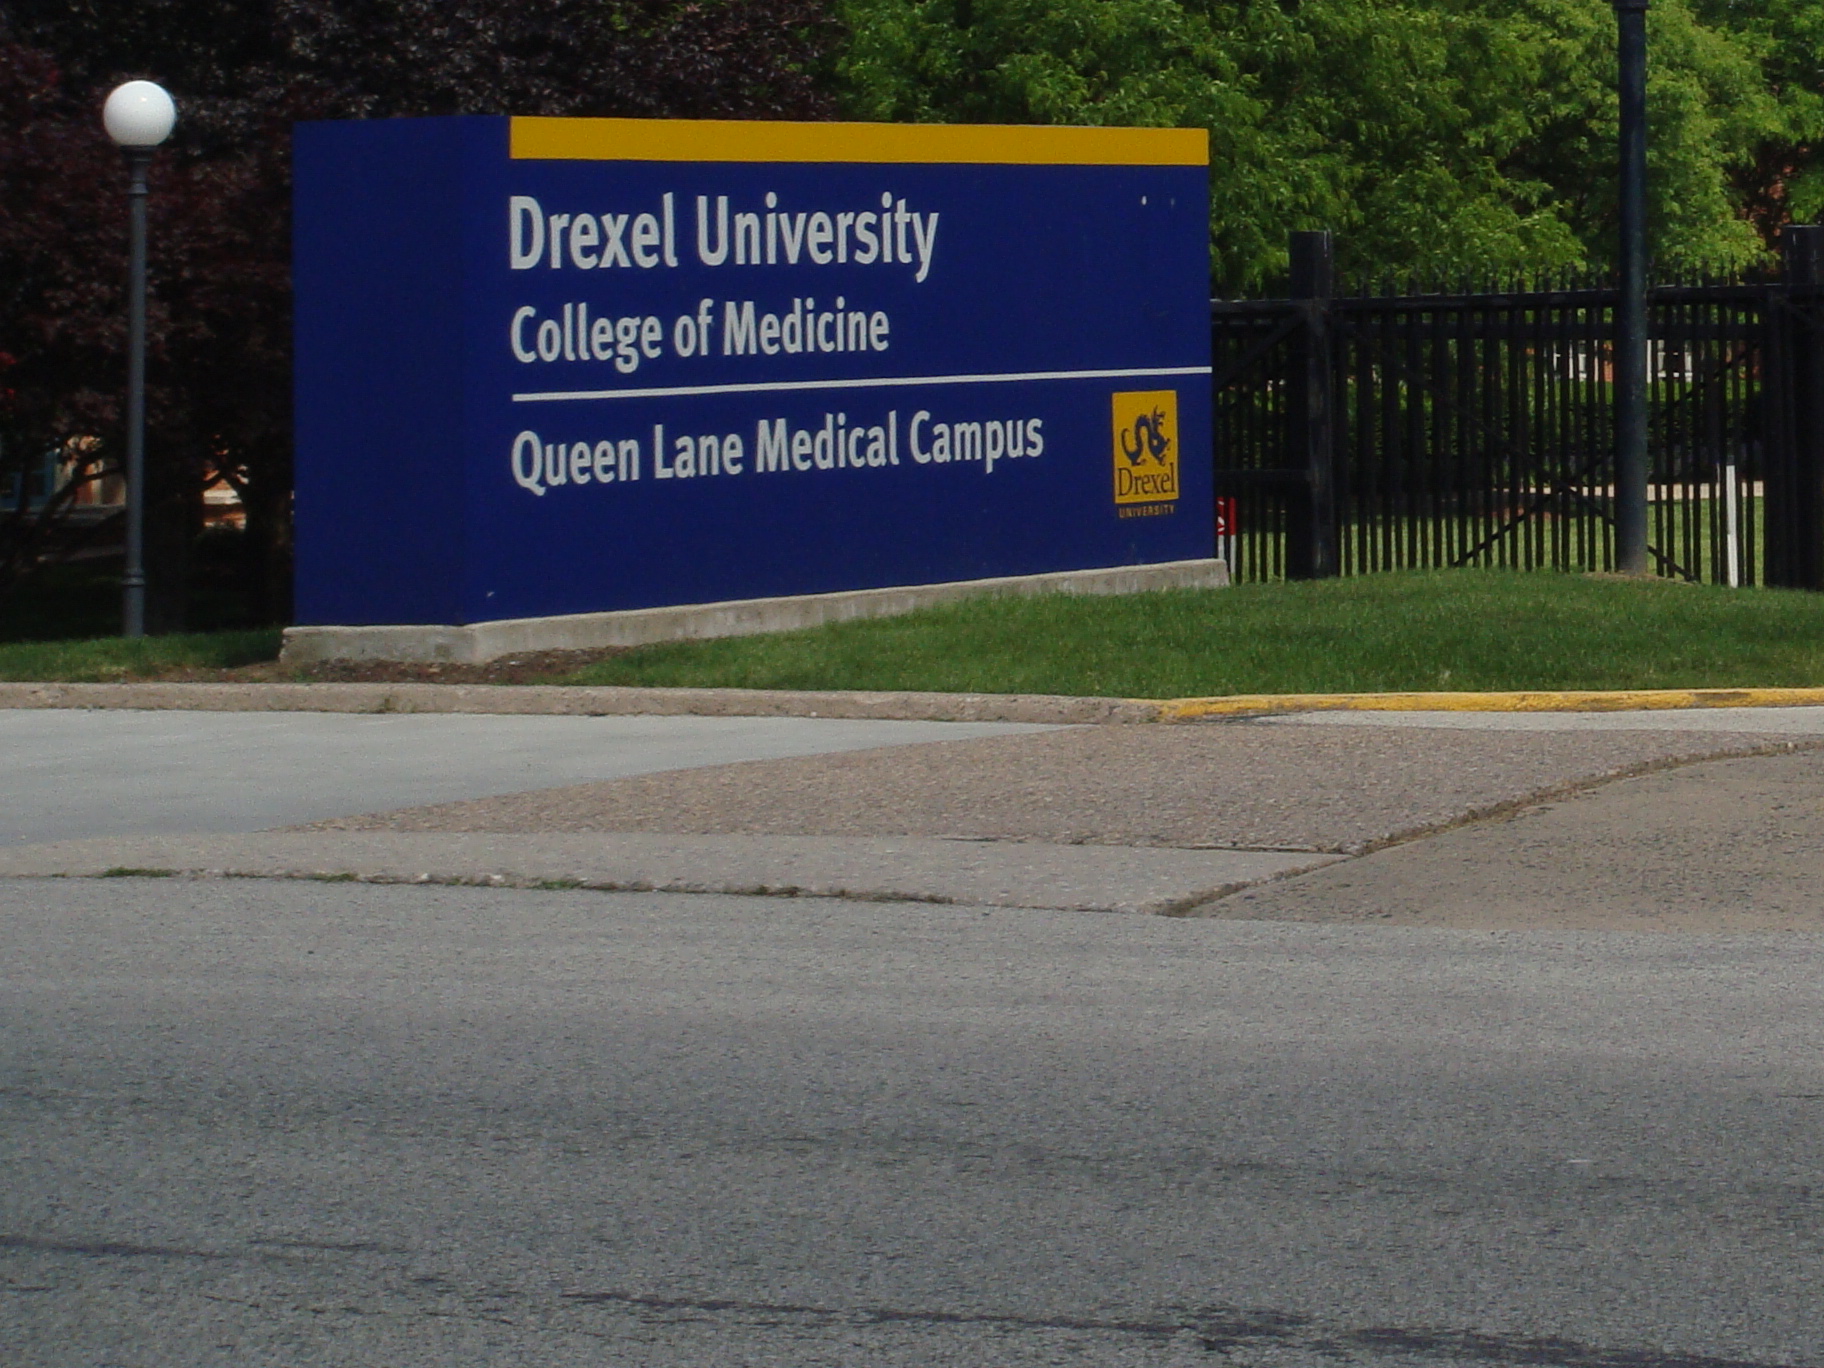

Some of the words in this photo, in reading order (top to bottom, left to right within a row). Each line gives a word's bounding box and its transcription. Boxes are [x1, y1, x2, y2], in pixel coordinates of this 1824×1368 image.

[509, 192, 678, 271] Drexel
[697, 191, 939, 284] University
[511, 304, 663, 374] College
[674, 298, 714, 358] of
[723, 297, 890, 357] Medicine
[512, 429, 640, 497] Queen
[653, 423, 743, 480] Lane
[756, 410, 899, 475] Medical
[910, 411, 1044, 474] Campus
[1117, 462, 1176, 497] Drexel
[1119, 504, 1175, 519] UNIVERSITY
